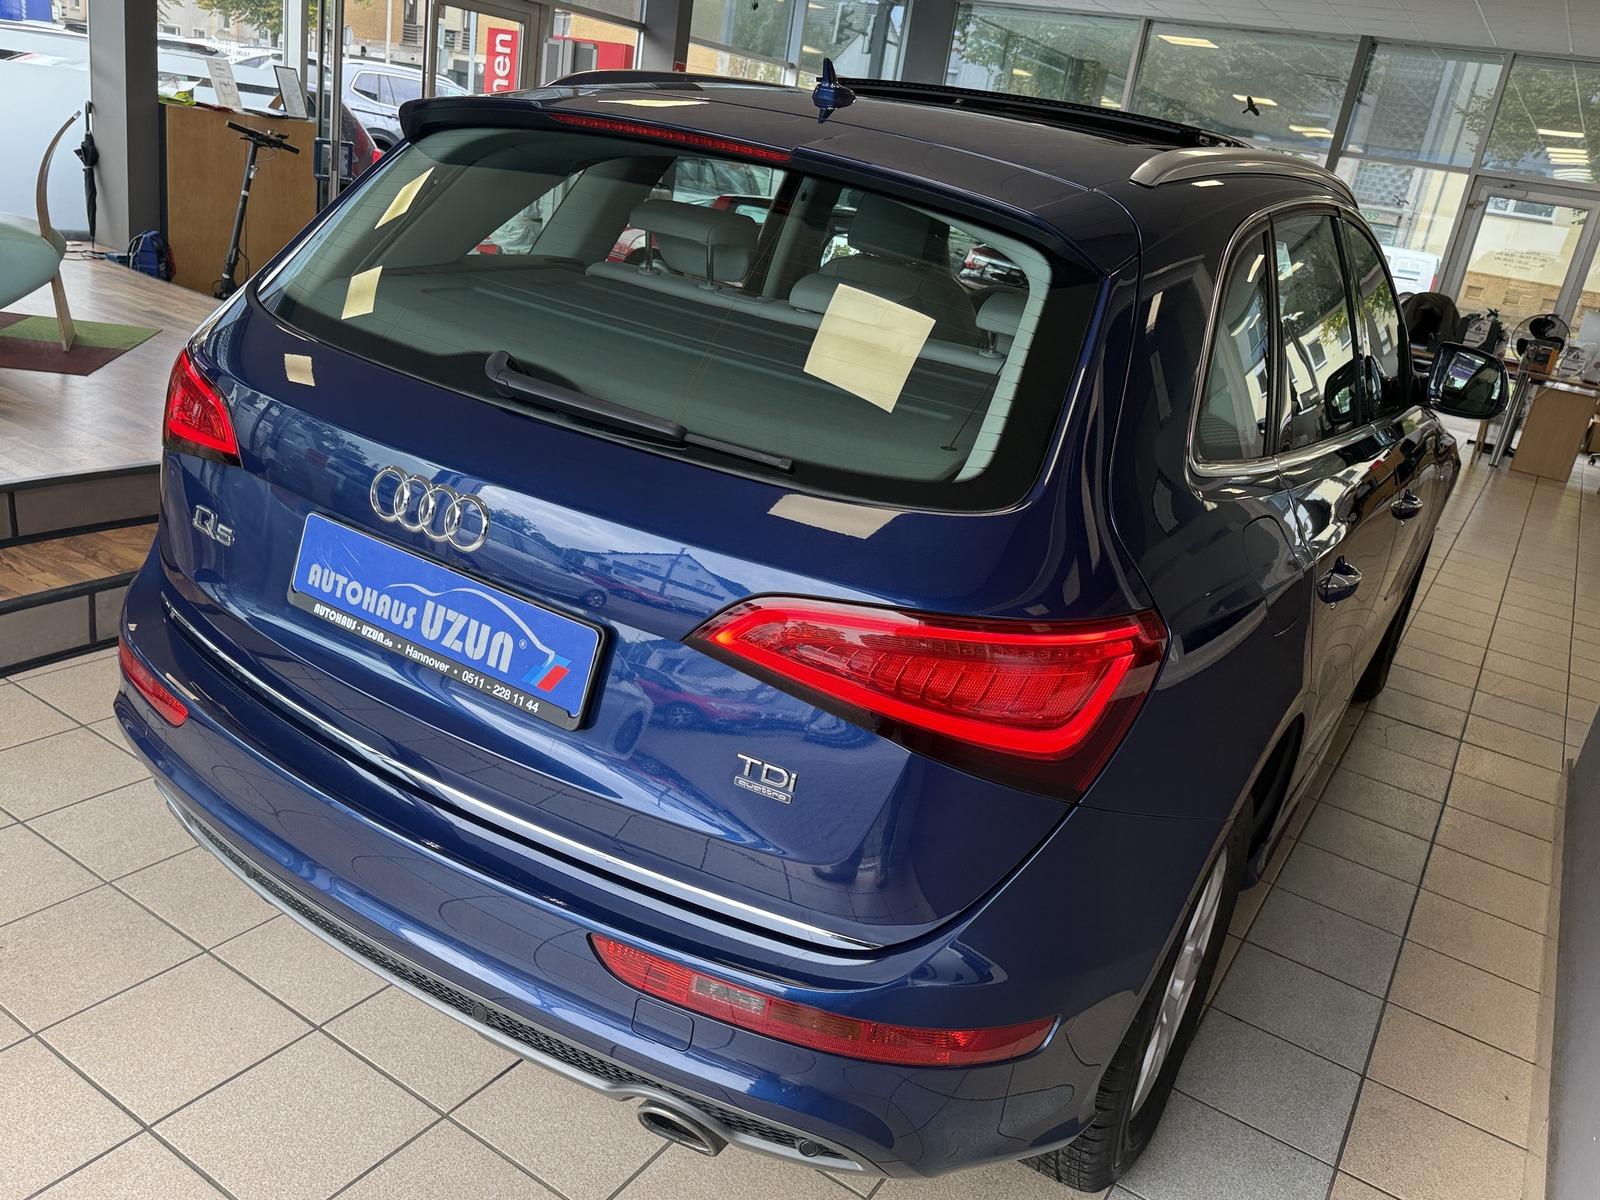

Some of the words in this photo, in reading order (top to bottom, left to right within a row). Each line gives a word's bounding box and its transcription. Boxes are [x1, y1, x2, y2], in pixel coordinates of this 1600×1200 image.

[193, 504, 235, 547] Q5
[307, 563, 417, 629] AUTOHAUS
[405, 644, 450, 673] Hannover
[461, 670, 485, 689] 0511
[492, 684, 511, 701] 228
[513, 693, 524, 707] 11
[525, 701, 540, 713] 44
[737, 753, 798, 793] TDI
[737, 779, 787, 801] quattro
